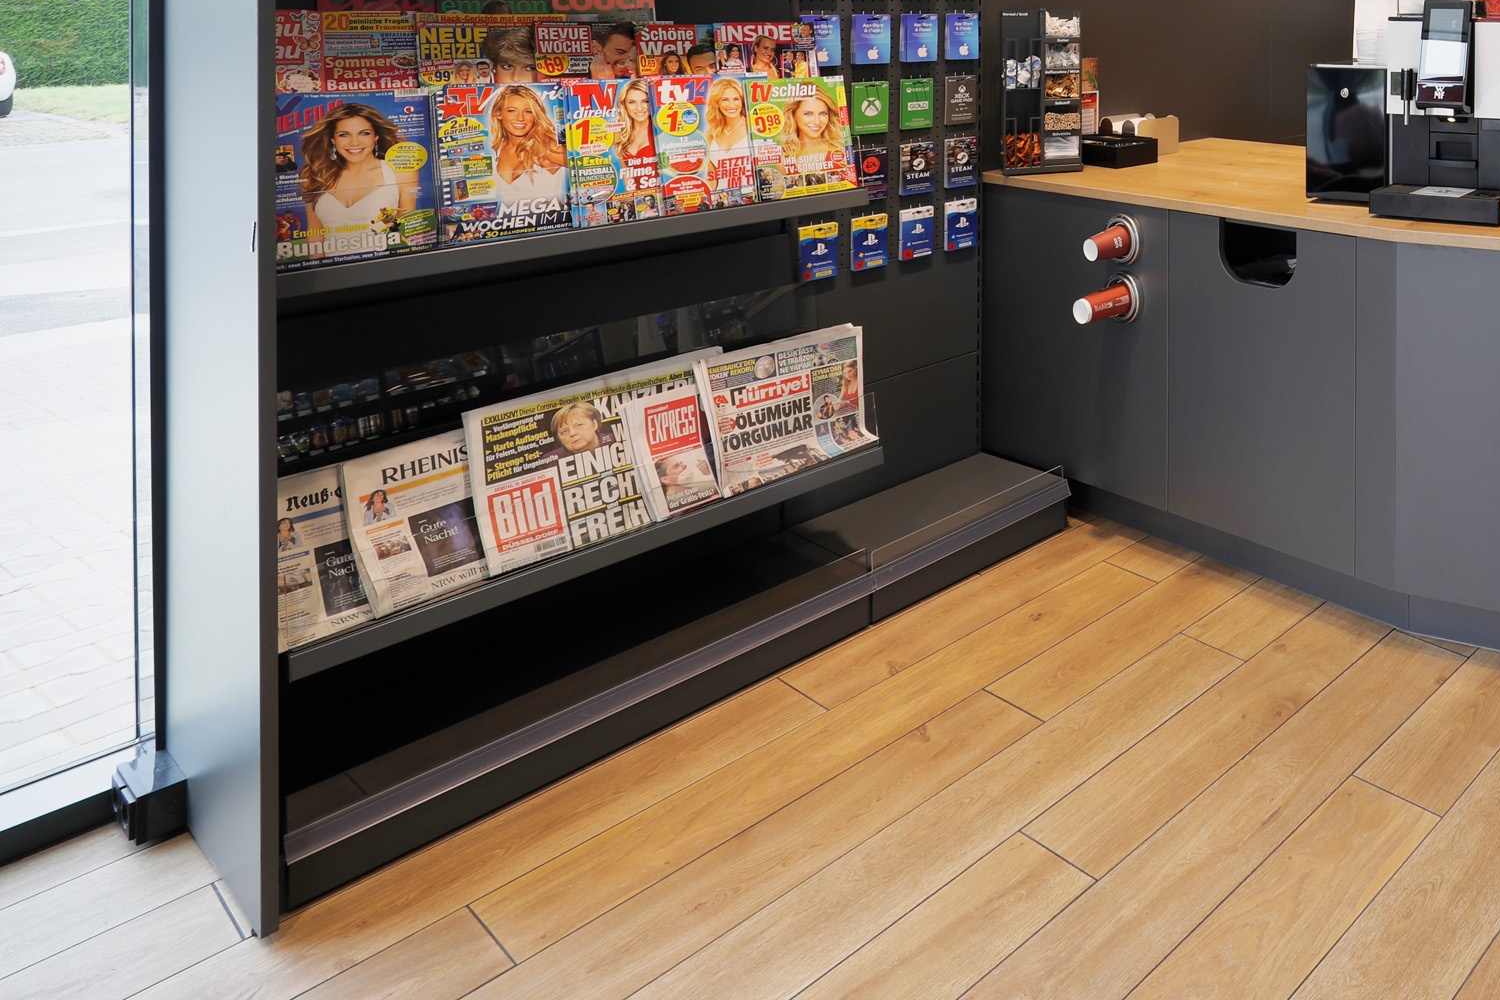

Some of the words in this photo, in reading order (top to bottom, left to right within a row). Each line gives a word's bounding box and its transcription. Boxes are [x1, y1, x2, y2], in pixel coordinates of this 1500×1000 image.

[325, 14, 349, 30] 20
[421, 28, 488, 43] NEUE
[538, 28, 589, 40] REVUE
[640, 26, 694, 40] Schöne
[721, 24, 791, 42] INSIDE
[540, 42, 589, 54] WOCHE
[640, 42, 692, 55] Welt
[326, 57, 392, 68] Sommer
[334, 68, 377, 79] Pasta
[327, 78, 376, 90] Bauch
[380, 77, 417, 89] flach
[574, 107, 617, 119] direkt
[909, 102, 928, 110] GOLD
[444, 124, 480, 135] Garantie!
[583, 155, 612, 167] Extra!
[628, 157, 641, 167] Die
[715, 156, 749, 168] JETZT!
[784, 157, 796, 165] IHR
[799, 154, 825, 163] SUPER
[579, 167, 614, 176] FUSSBALL
[620, 166, 655, 179] Filme,
[708, 167, 754, 181] SERIEN-
[784, 161, 834, 175] TV-SOMMER
[579, 173, 615, 182] BUNDESLIGA
[583, 180, 610, 188] PLANER
[498, 197, 560, 218] MEGA
[461, 214, 536, 232] WOCHEN
[293, 225, 331, 239] Endlich
[277, 232, 401, 258] Bundesliga
[733, 375, 808, 407] Hürriyet
[484, 410, 519, 424] EXKLUSIV!
[519, 404, 535, 416] Diese
[536, 395, 579, 413] Corona-Regeln
[736, 396, 811, 430] ÖLÜMÜNE
[647, 404, 695, 446] EXPRESS
[485, 423, 537, 443] Maskenpflicht
[723, 414, 812, 453] YORGUNLAR
[493, 440, 514, 453] Harte
[516, 430, 549, 447] Auflagen
[496, 448, 517, 460] Feiern,
[517, 443, 537, 455] Discos,
[537, 437, 555, 449] Clubs
[487, 468, 512, 481] Pflicht
[523, 454, 559, 472] Ungeimpfte
[494, 456, 524, 472] Strenge
[524, 451, 543, 463] Test-
[667, 490, 683, 501] Heute
[669, 501, 680, 509] der
[681, 488, 715, 505] Gratis-Tests?
[493, 482, 558, 541] Bild
[420, 519, 447, 534] Gute
[424, 525, 459, 545] Nacht!
[502, 529, 558, 551] DÜSSELDORF
[431, 576, 458, 590] NRW
